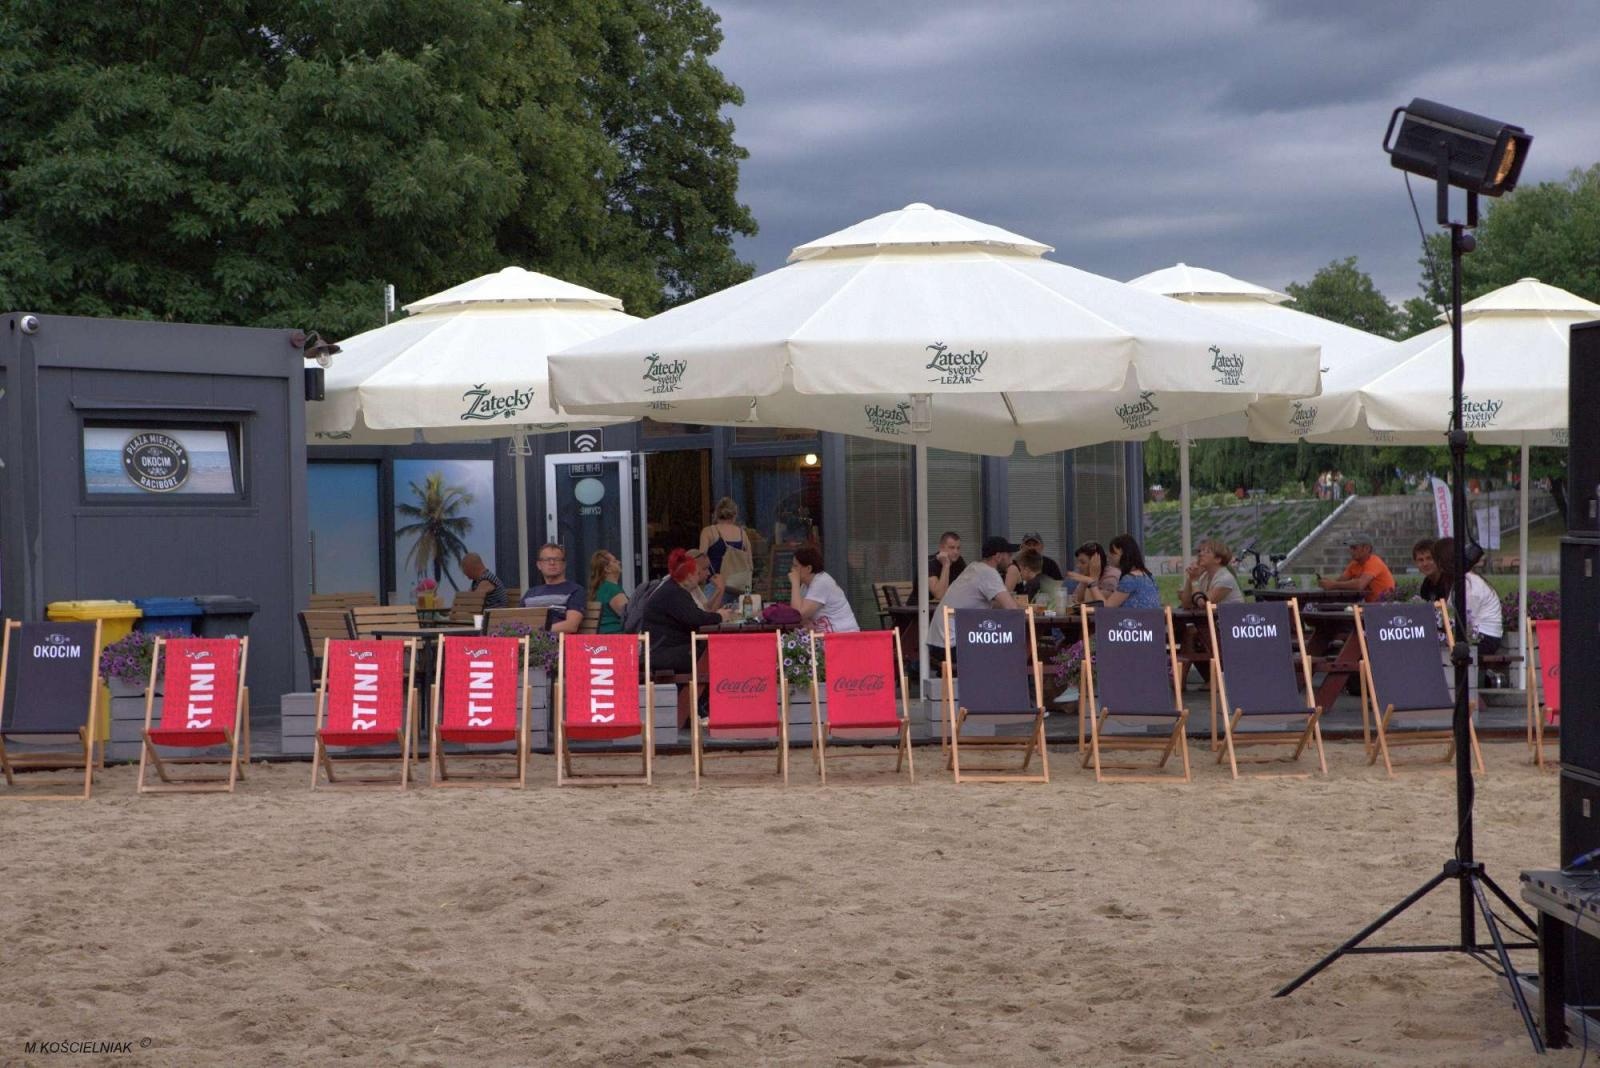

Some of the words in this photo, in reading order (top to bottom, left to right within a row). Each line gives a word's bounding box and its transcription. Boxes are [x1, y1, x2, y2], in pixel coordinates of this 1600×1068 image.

[460, 382, 535, 420] Žatecký
[141, 456, 172, 467] OKOCIM
[968, 631, 1013, 644] OKOCIM
[1108, 629, 1153, 643] OKOCIM
[1232, 625, 1277, 639] OKOCIM
[1380, 626, 1425, 641] OKOCIM
[33, 645, 81, 658] OKOCIM
